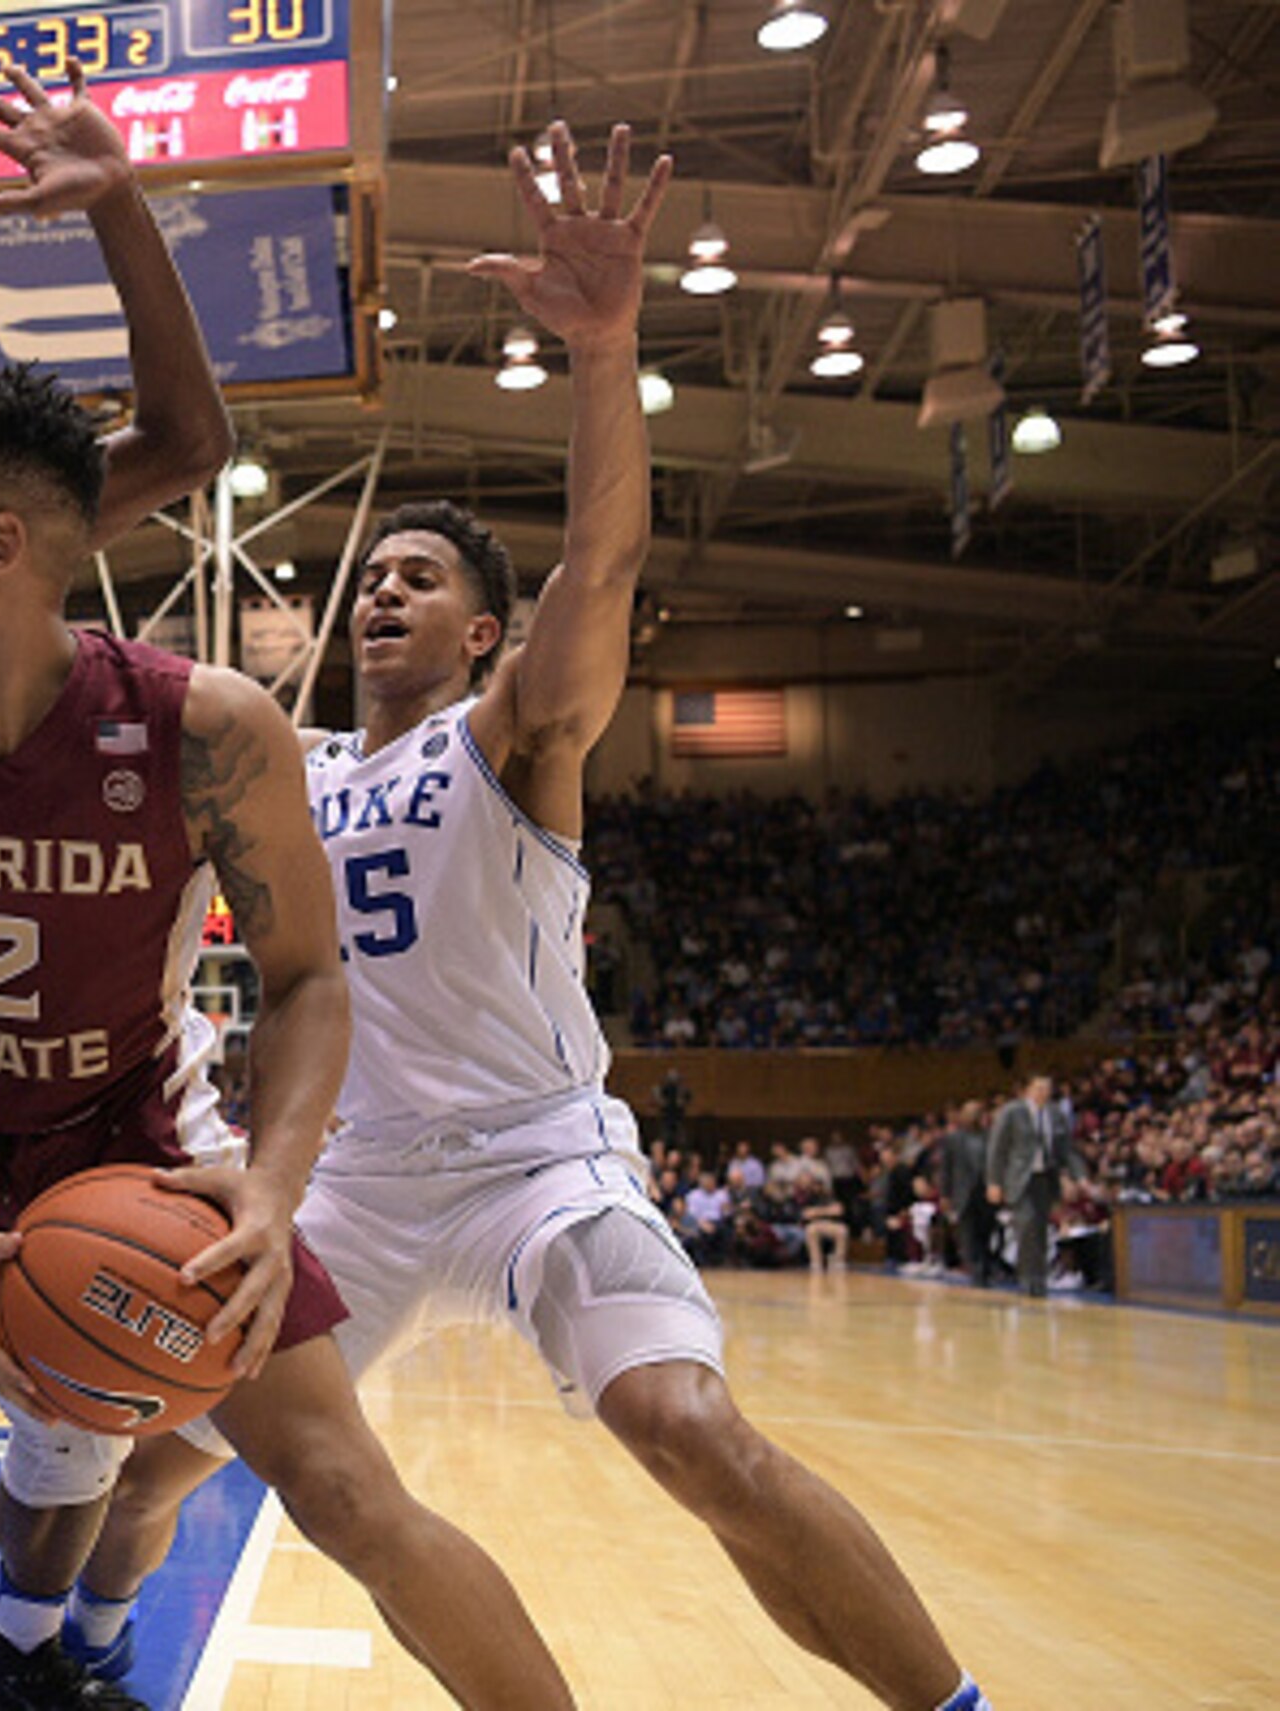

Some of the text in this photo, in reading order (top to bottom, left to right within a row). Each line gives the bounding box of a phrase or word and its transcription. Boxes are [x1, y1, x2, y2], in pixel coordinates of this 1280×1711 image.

[127, 29, 152, 66] 2
[310, 772, 451, 841] UKE
[340, 847, 419, 962] 5
